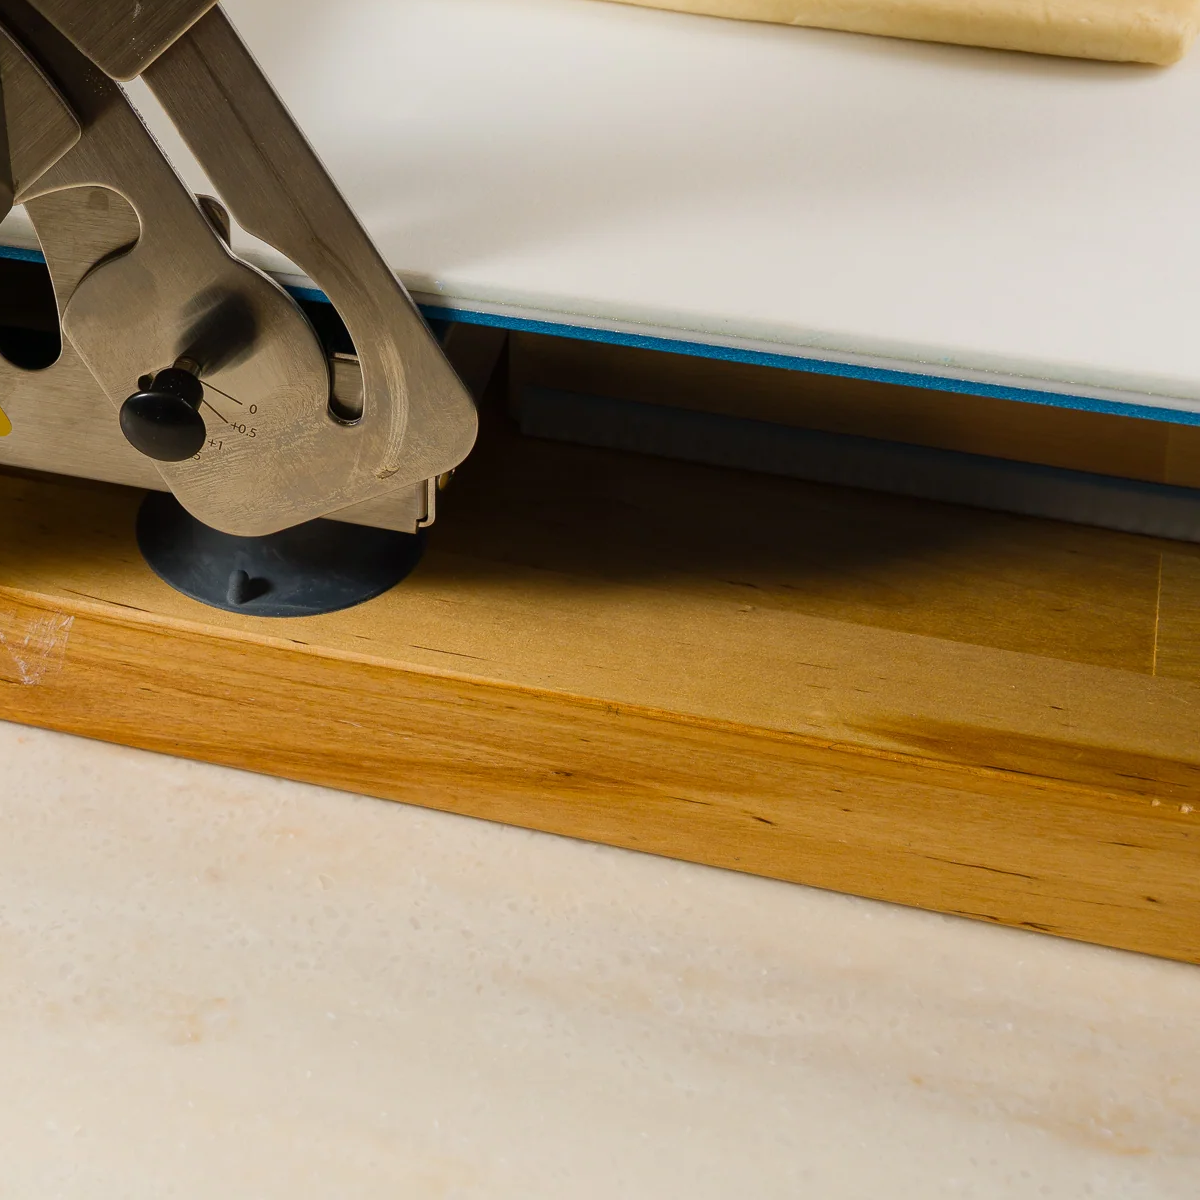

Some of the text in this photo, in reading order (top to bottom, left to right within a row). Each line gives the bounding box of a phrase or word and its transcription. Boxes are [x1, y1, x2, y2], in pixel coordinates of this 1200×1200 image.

[249, 404, 258, 415] 0
[230, 422, 258, 438] +0.5
[208, 439, 223, 451] +1
